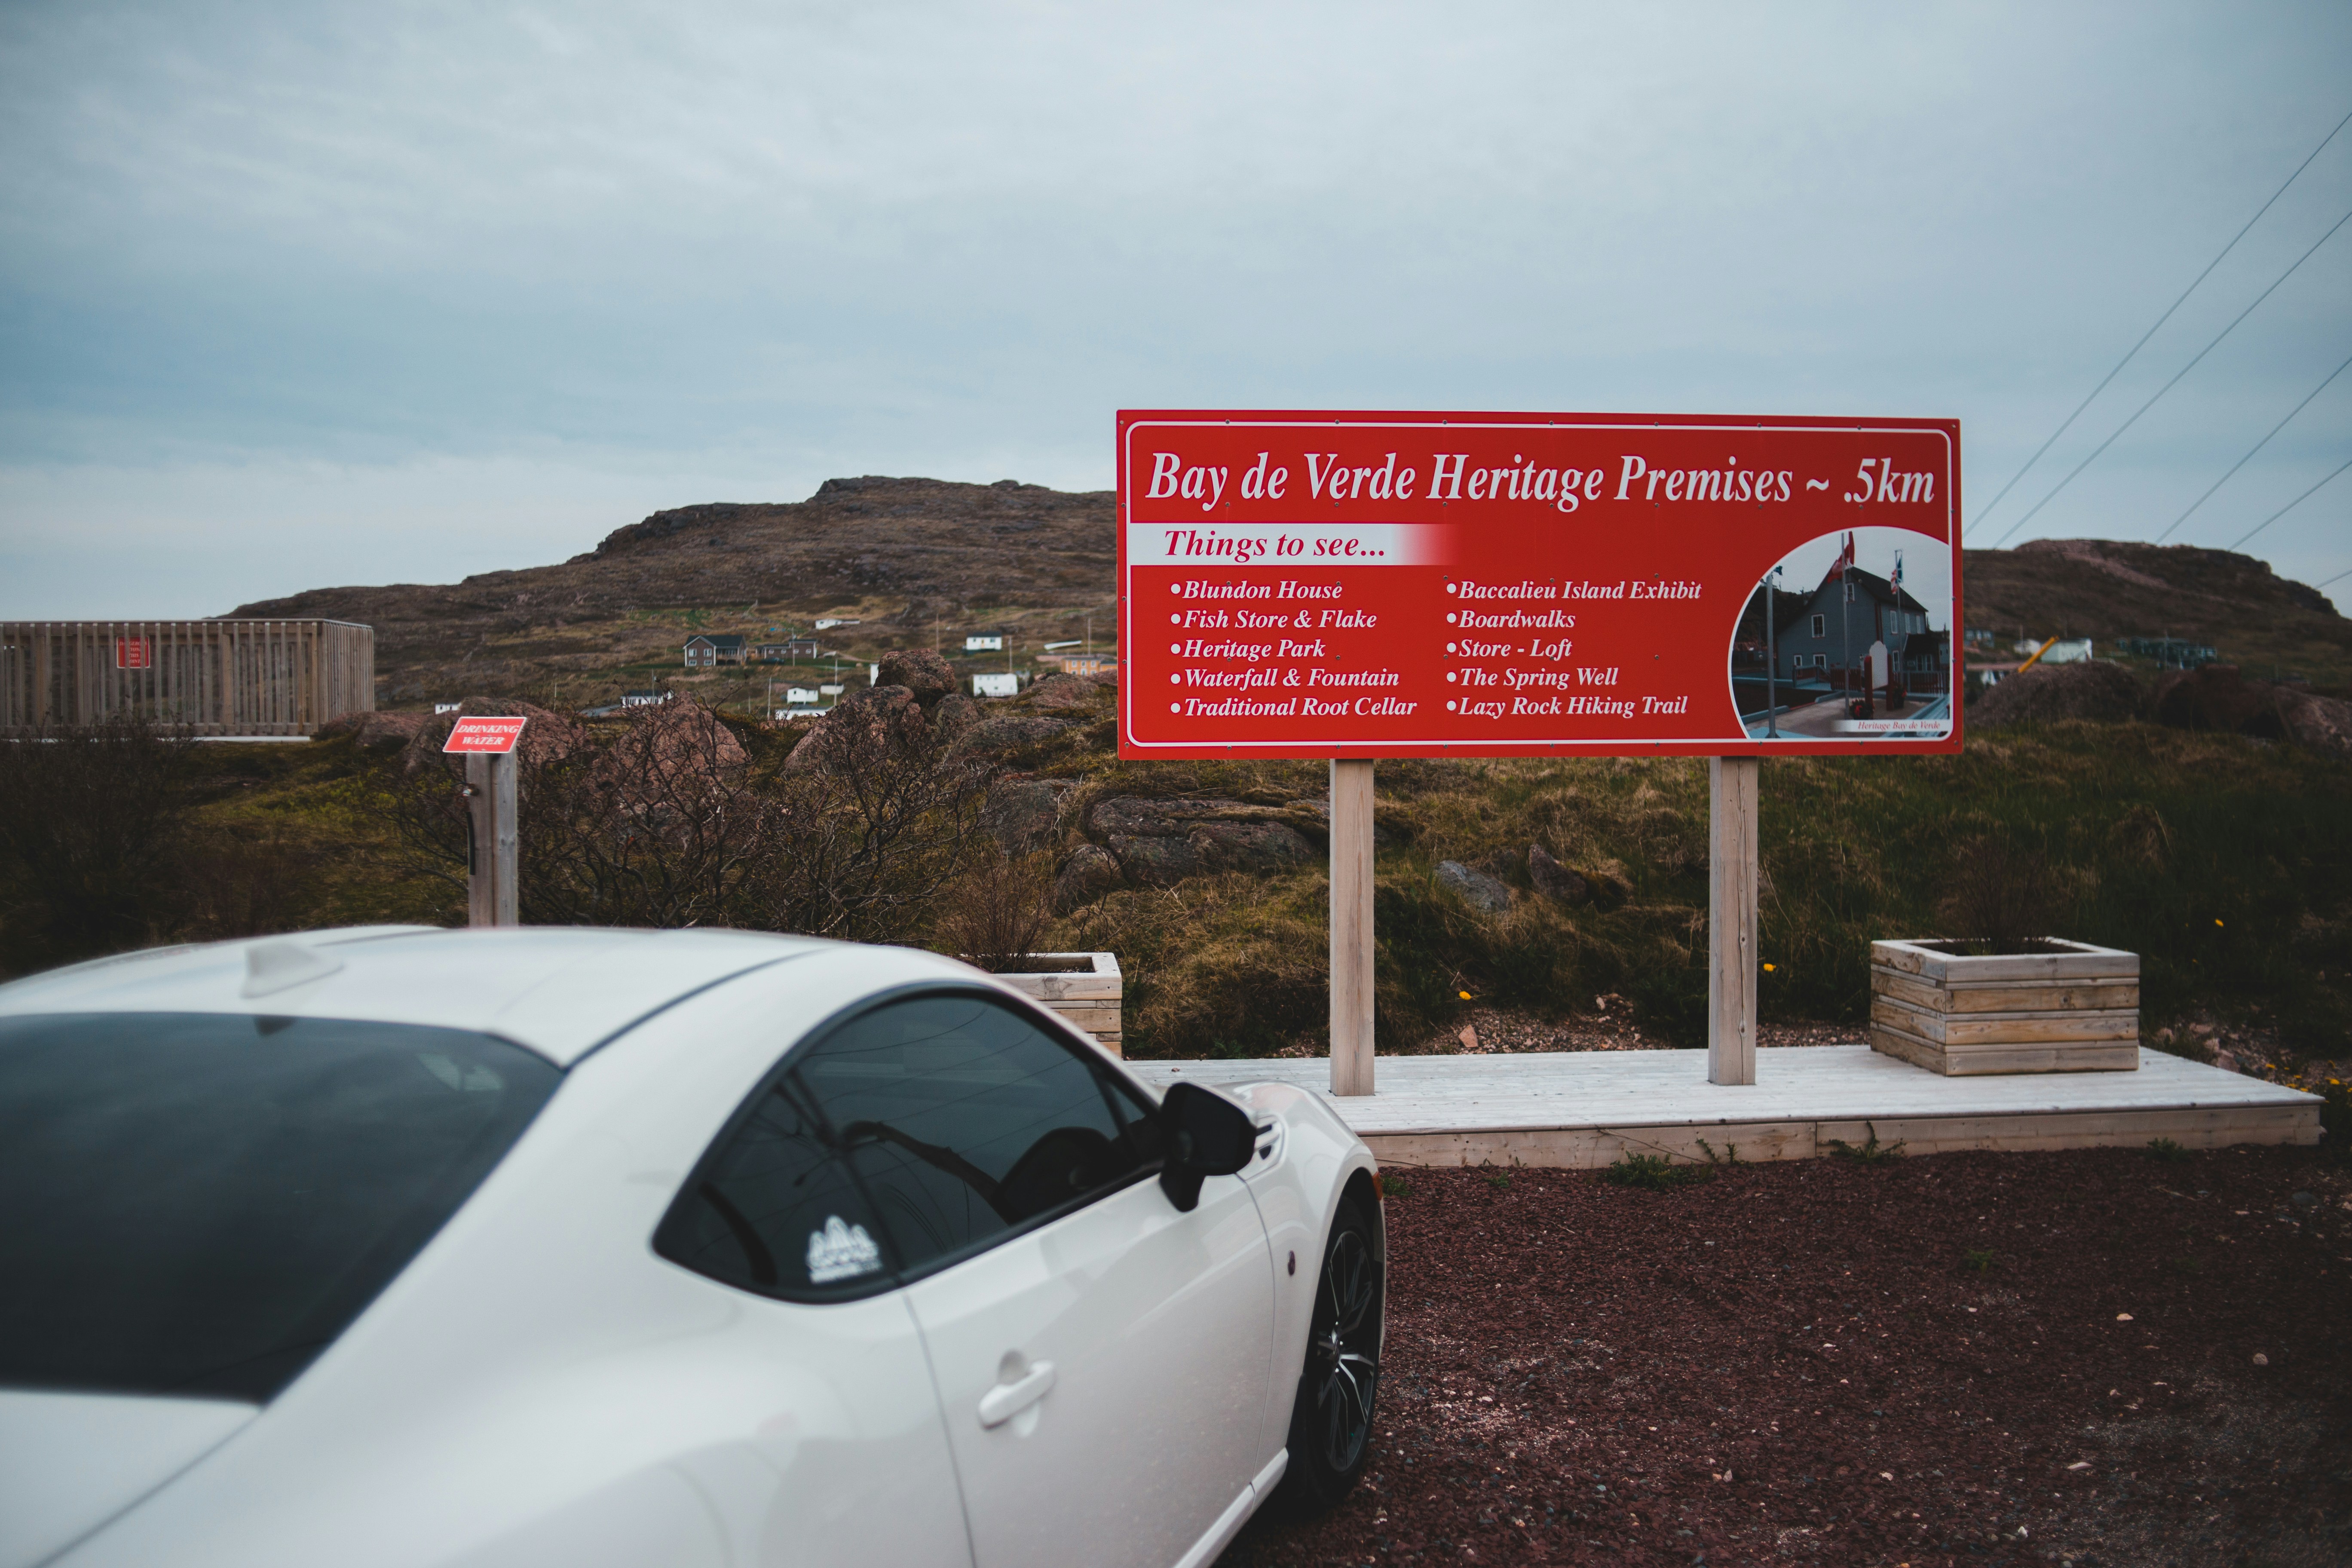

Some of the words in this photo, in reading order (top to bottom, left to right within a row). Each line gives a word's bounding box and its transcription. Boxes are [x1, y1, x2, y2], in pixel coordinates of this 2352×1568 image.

[1145, 453, 1228, 511] Bay
[1241, 452, 1288, 499] de
[1304, 452, 1415, 499] Verde
[1425, 454, 1604, 513] Heritage
[1614, 456, 1792, 502] Premises
[1844, 458, 1934, 503] .5km
[1165, 530, 1267, 563] Things
[1276, 534, 1304, 556] to
[1313, 539, 1384, 556] see...
[1182, 580, 1271, 599] Blundon
[1276, 581, 1342, 599] House
[1458, 581, 1556, 599] Baccalieu
[1561, 581, 1625, 599] Island
[1629, 581, 1702, 599] Exhibit
[1182, 609, 1228, 628] Fish
[1234, 610, 1288, 628] Store
[1293, 610, 1312, 628] &
[1318, 609, 1377, 628] Flake
[1458, 609, 1575, 628] Boardwalks
[1182, 639, 1272, 662] Heritage
[1276, 639, 1326, 657] Park
[1458, 639, 1511, 657] Store
[1529, 638, 1572, 661] Loft
[1185, 668, 1278, 691] Waterfall
[1283, 668, 1301, 686] &
[1307, 668, 1399, 686] Fountain
[1461, 668, 1498, 686] The
[1503, 668, 1570, 690] Spring
[1576, 667, 1618, 686] Well
[1185, 698, 1297, 716] Traditional
[1300, 698, 1350, 715] Root
[1354, 697, 1417, 715] Cellar
[1458, 697, 1506, 720] Lazy
[1510, 696, 1562, 714] Rock
[1565, 696, 1635, 719] Hiking
[1642, 696, 1688, 714] Trail
[456, 725, 520, 733] DRINKING
[1858, 721, 1890, 731] Heritage
[1893, 721, 1906, 731] Bay
[462, 736, 505, 745] WATER
